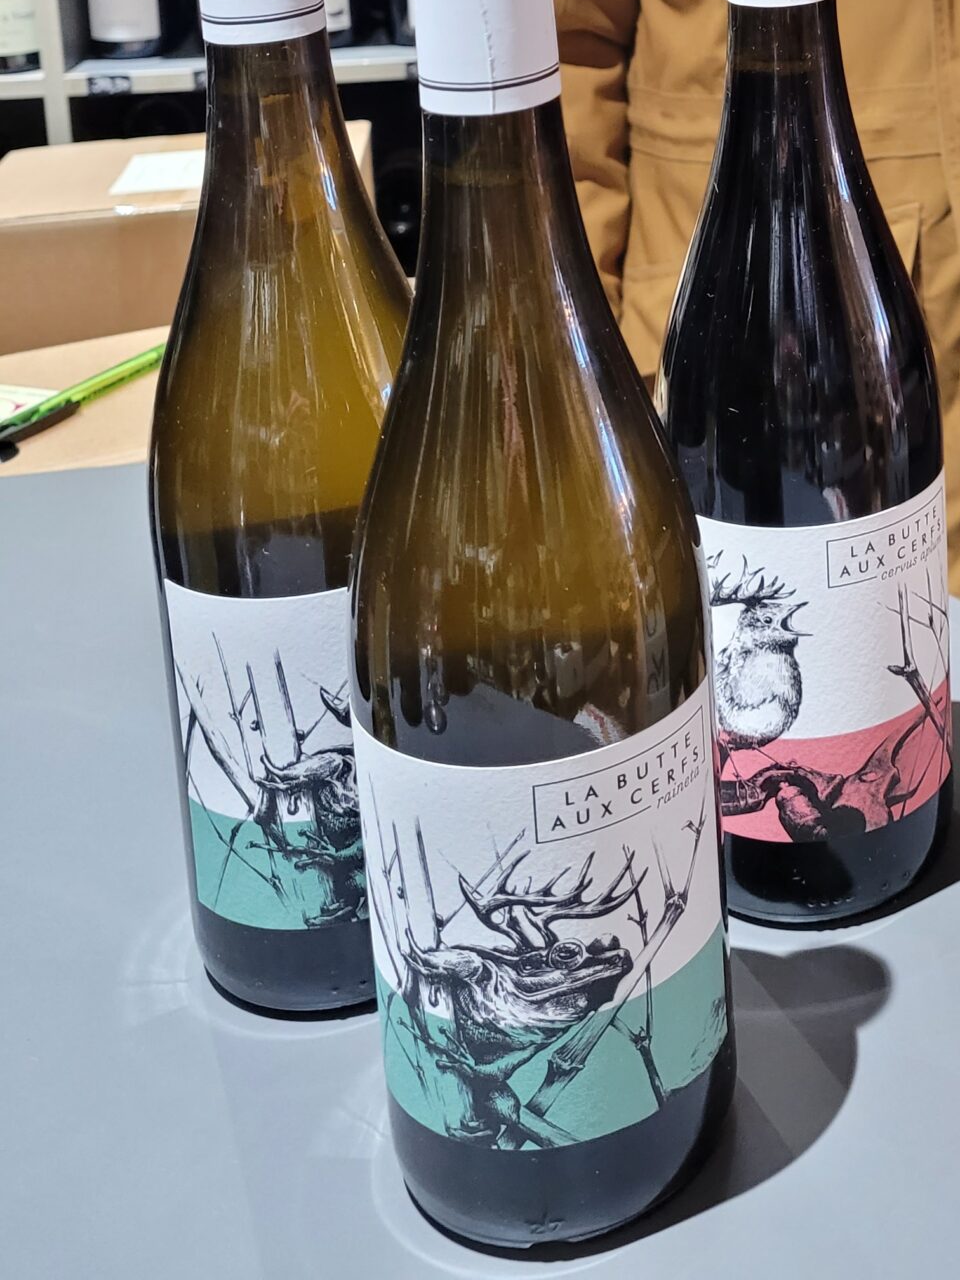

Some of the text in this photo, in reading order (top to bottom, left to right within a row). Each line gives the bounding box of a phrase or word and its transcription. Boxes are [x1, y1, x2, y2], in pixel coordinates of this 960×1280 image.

[839, 517, 941, 579] AUX CERFS
[850, 505, 937, 559] LA BUTTE
[880, 555, 918, 582] cervus
[551, 745, 700, 832] AUX CERFS
[564, 731, 692, 807] LA BUTTE
